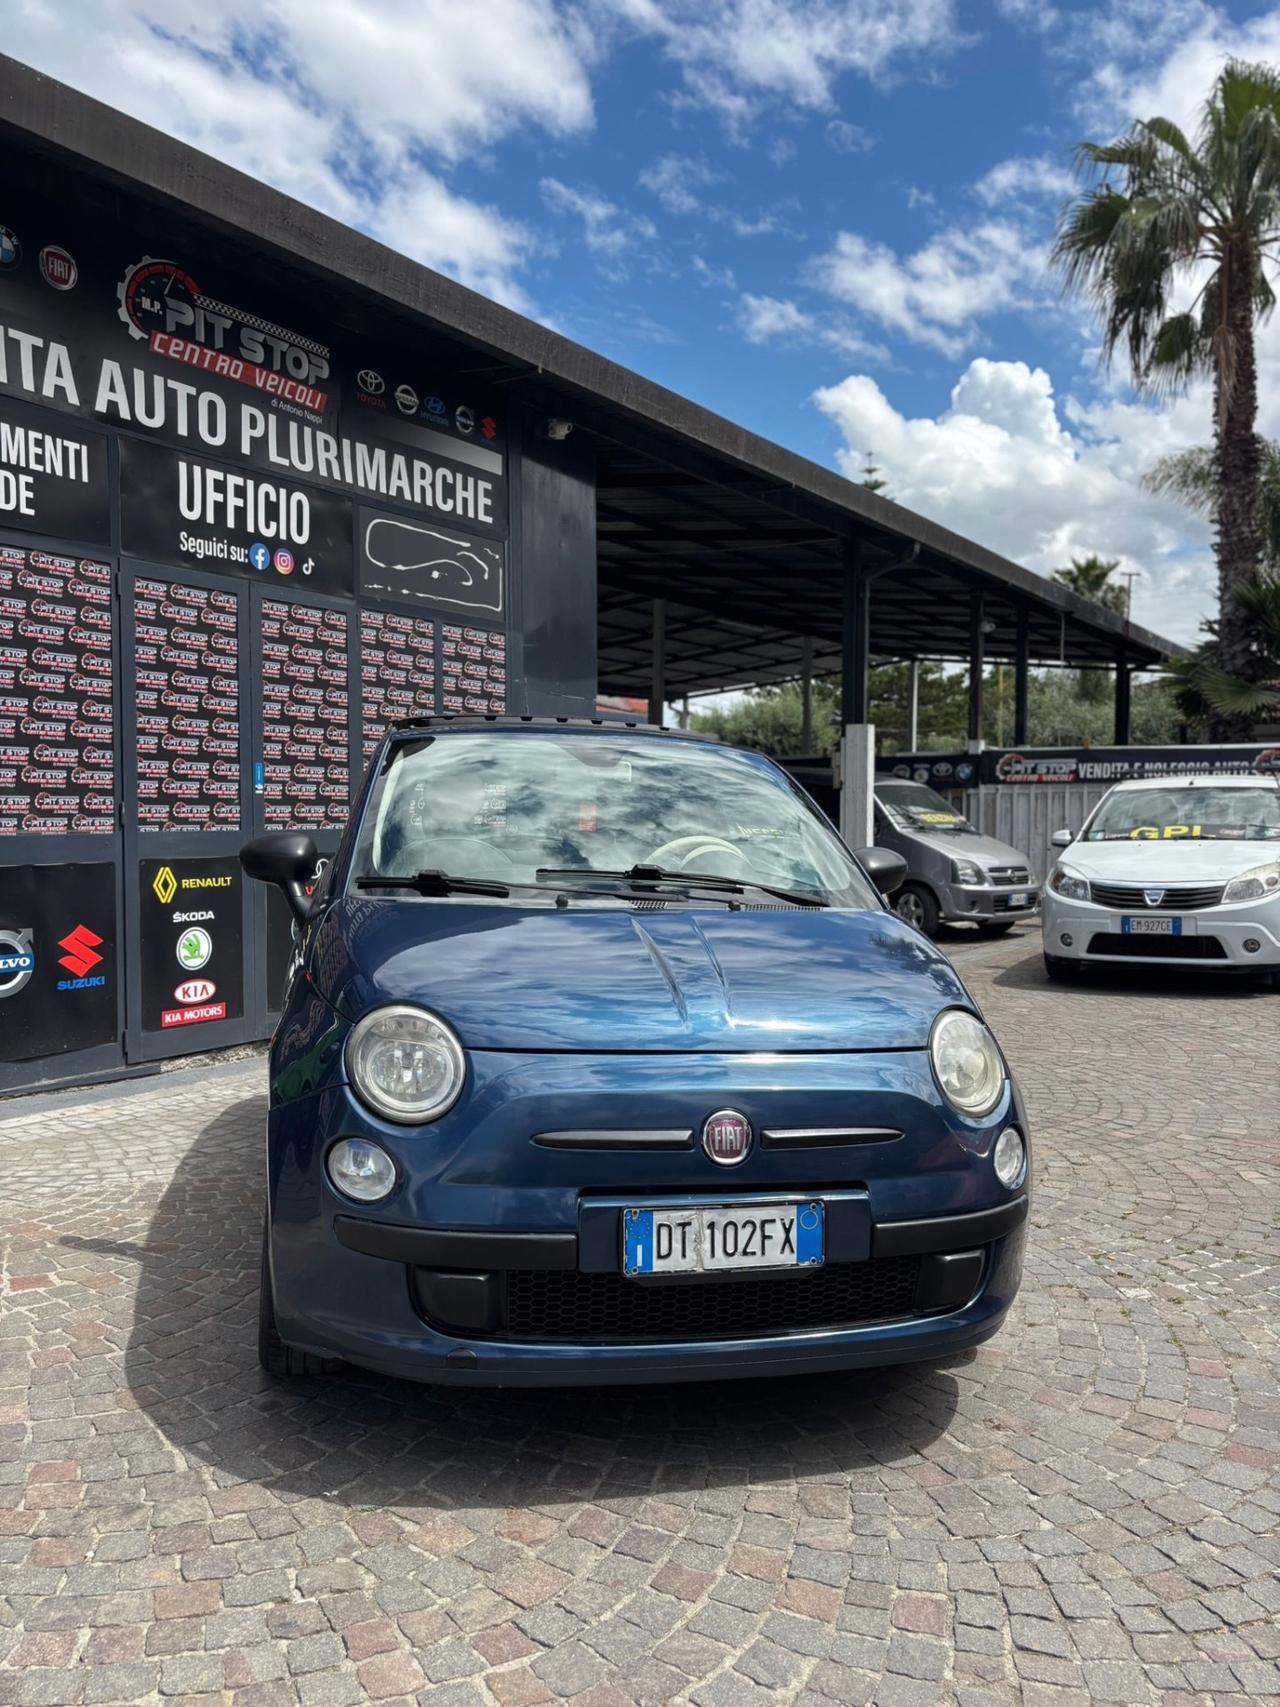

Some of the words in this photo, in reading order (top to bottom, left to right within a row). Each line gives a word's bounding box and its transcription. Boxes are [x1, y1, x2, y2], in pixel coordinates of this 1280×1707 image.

[48, 256, 69, 280] FIAT
[164, 296, 233, 349] PIT
[240, 327, 330, 385] STOP
[279, 401, 303, 417] Antonio
[357, 393, 385, 408] TOYOTA
[95, 358, 226, 446] AUTO
[241, 403, 493, 524] PLURIMARCHE
[0, 422, 89, 483] MENTI
[178, 460, 310, 545] UFFICIO
[179, 531, 228, 559] Seguici
[230, 545, 249, 564] su:
[1011, 763, 1035, 774] PIT
[1036, 763, 1077, 774] STOP
[1130, 825, 1216, 840] GPL
[181, 877, 232, 888] RENAULT
[172, 910, 215, 923] ŠKODA
[56, 976, 105, 990] SUZUKI
[182, 984, 209, 999] KIA
[164, 1012, 181, 1024] KIA
[183, 1005, 223, 1021] MOTORS
[714, 1127, 741, 1151] FIAT
[656, 1221, 692, 1260] DT
[707, 1218, 795, 1259] 102FX
